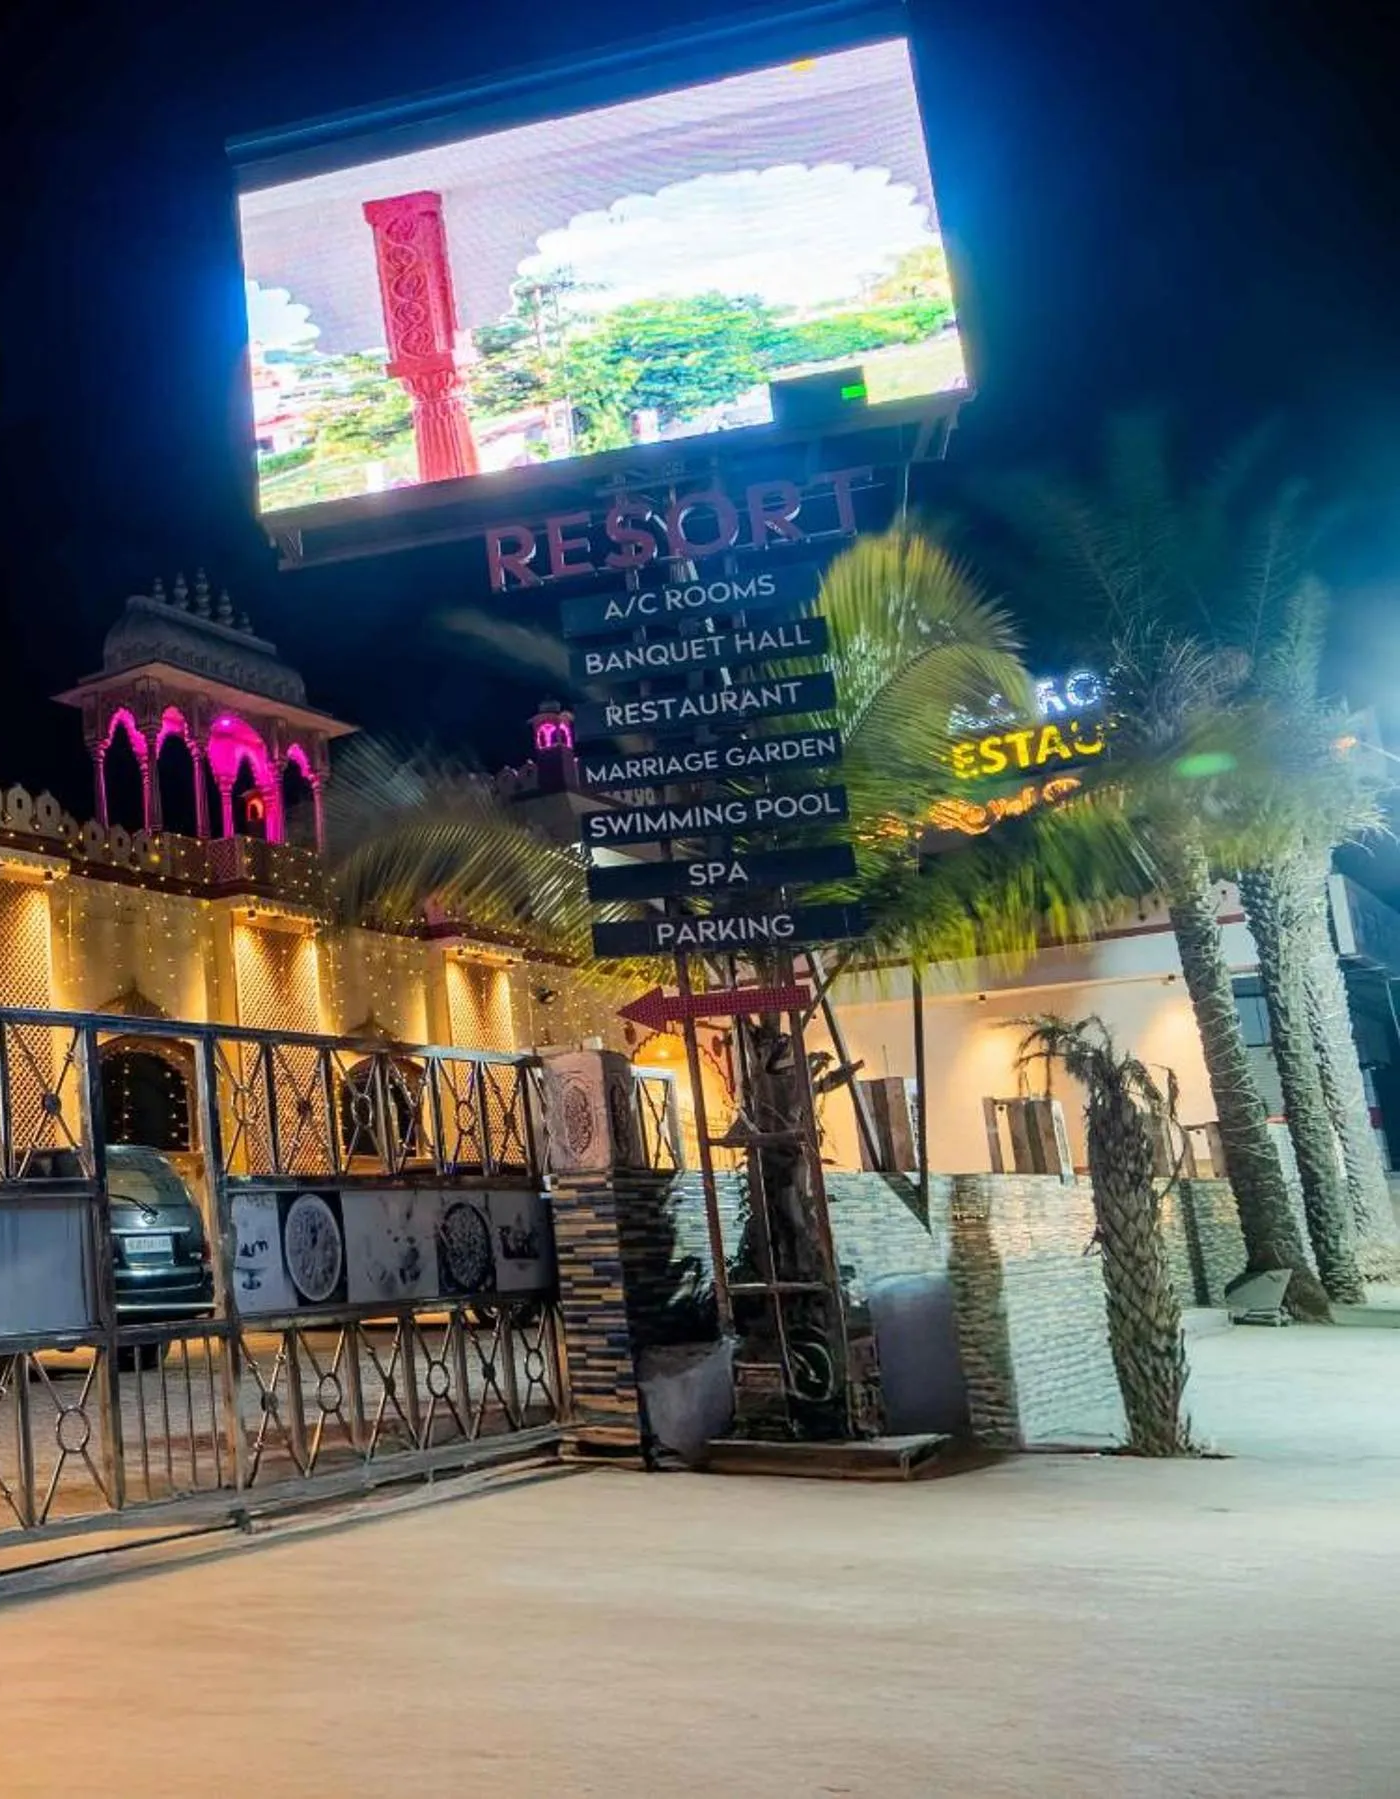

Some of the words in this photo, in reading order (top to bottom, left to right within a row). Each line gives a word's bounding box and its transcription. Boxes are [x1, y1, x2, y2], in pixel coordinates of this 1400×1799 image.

[486, 466, 872, 592] RESORT
[604, 593, 658, 620] A/C
[664, 574, 776, 609] ROOMS
[585, 635, 726, 675] BANQUET
[735, 623, 811, 653] HALL
[605, 682, 803, 727] RESTAURANT
[585, 750, 718, 785] MARRIAGE
[725, 735, 836, 764] GARDEN
[589, 800, 748, 838] SWIMMING
[756, 792, 840, 819] POOL
[688, 864, 748, 886] SPA
[657, 914, 795, 945] PARKING
